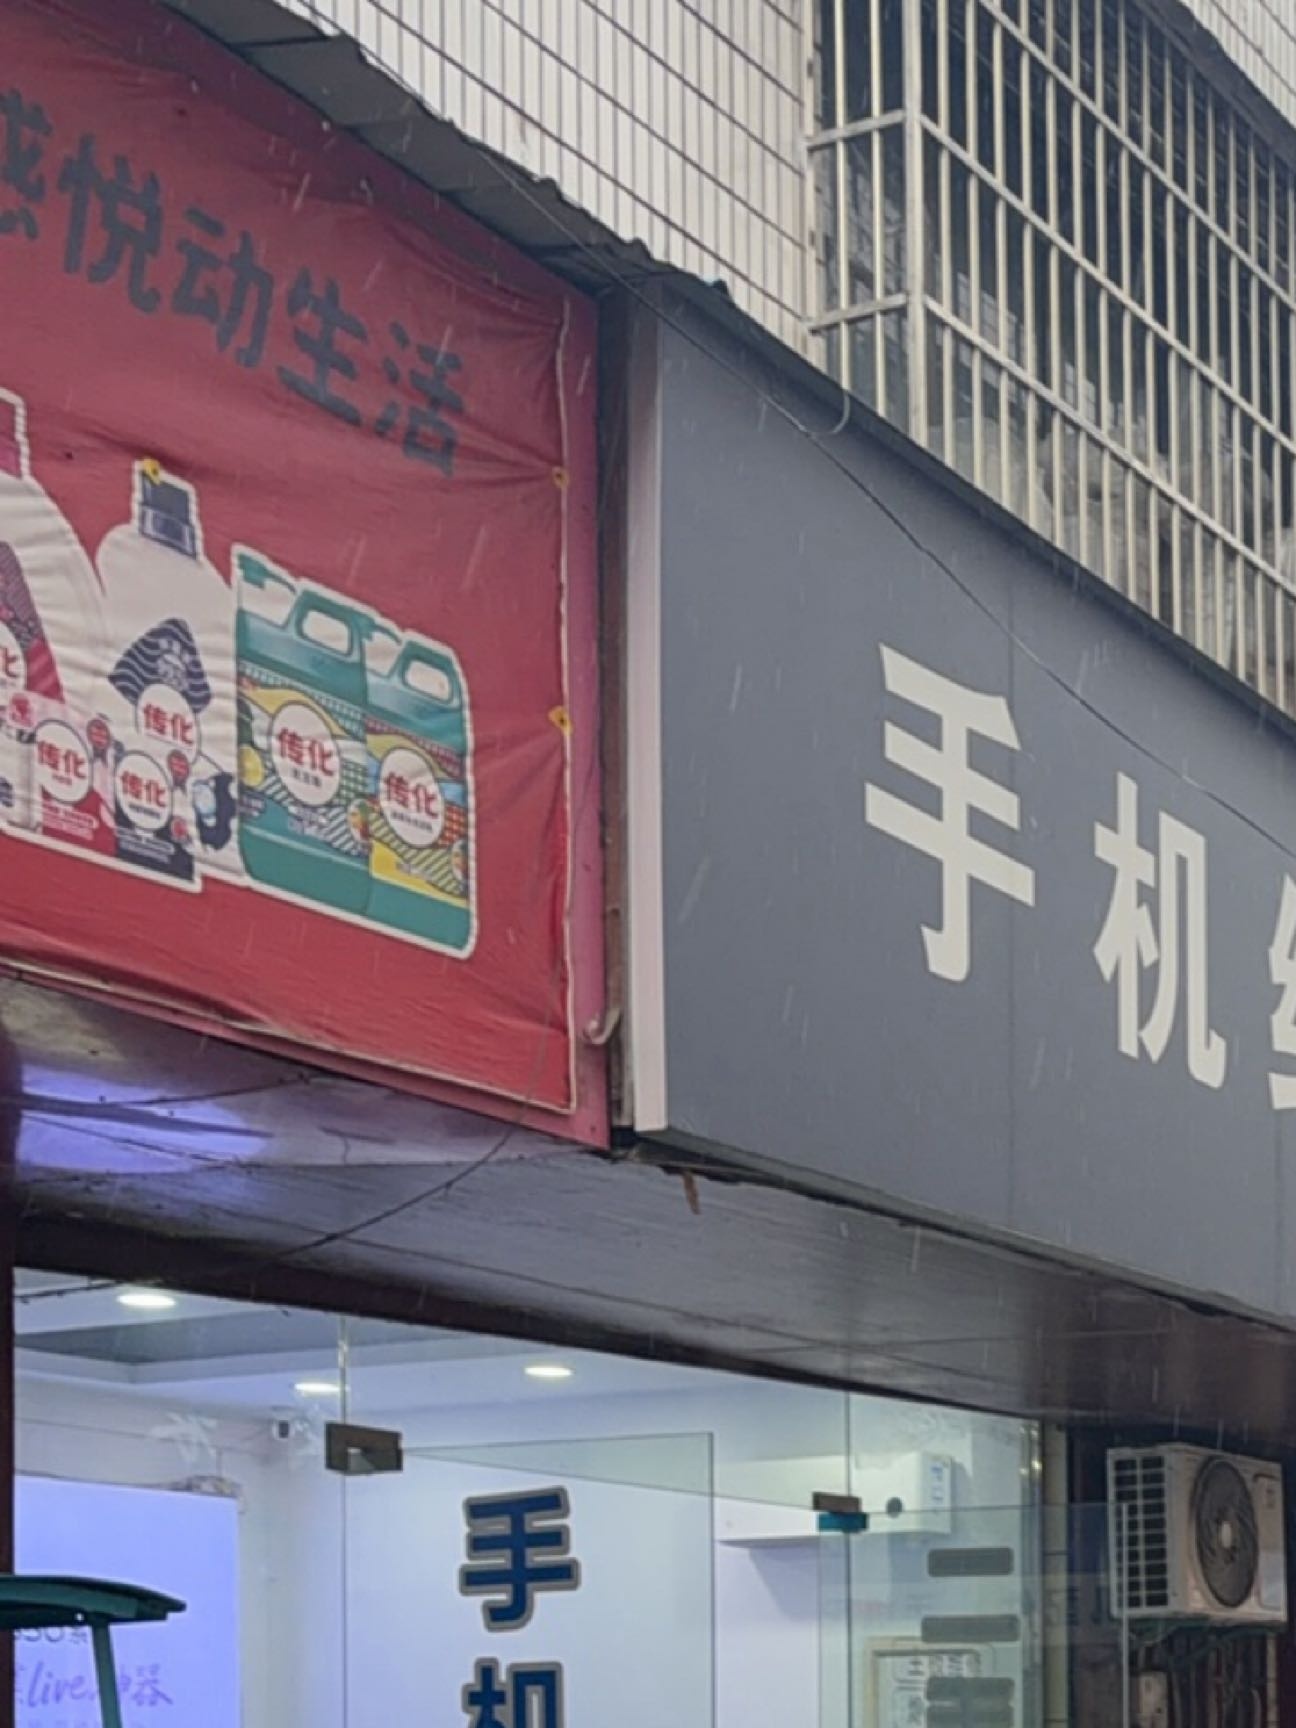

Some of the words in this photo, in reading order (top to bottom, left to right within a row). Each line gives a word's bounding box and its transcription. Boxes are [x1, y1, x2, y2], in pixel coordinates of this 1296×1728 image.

[142, 702, 195, 745] 传化
[36, 739, 87, 780] 传化
[277, 726, 334, 777] 传化
[120, 769, 167, 809] 传化
[383, 771, 439, 820] 传化
